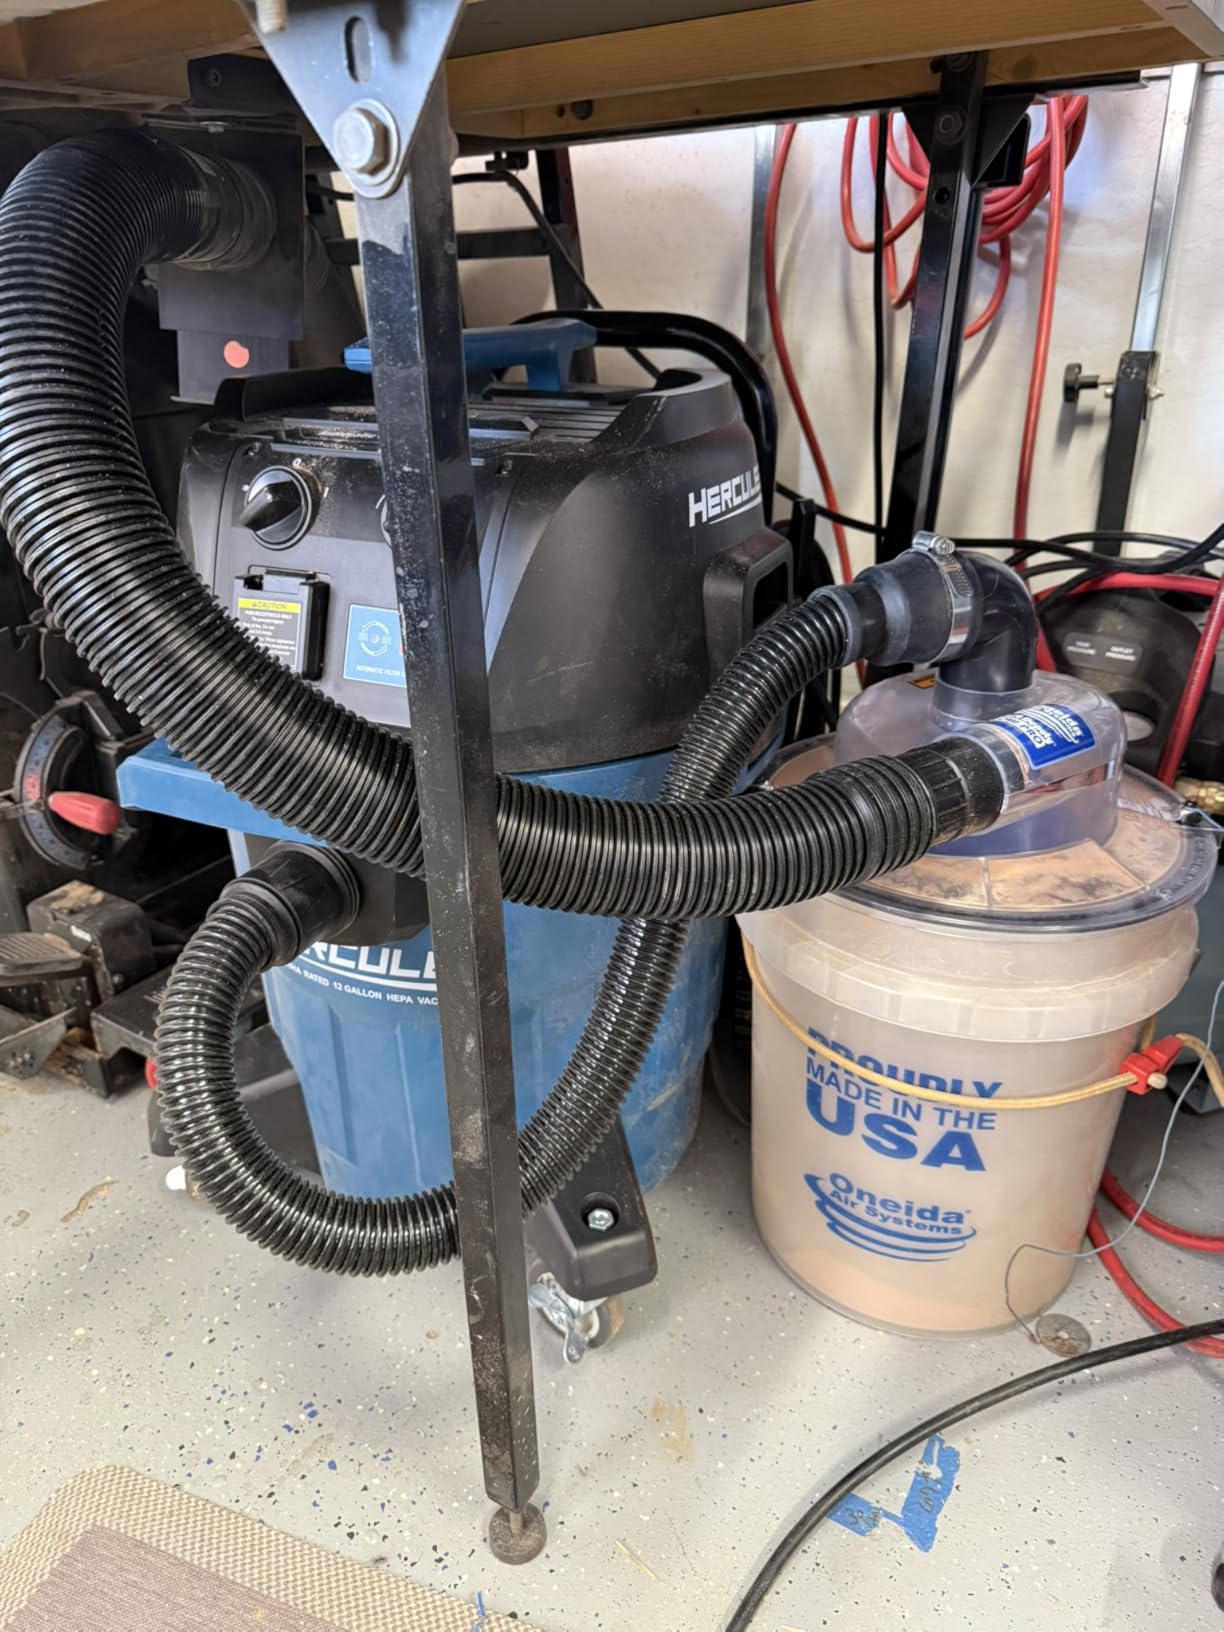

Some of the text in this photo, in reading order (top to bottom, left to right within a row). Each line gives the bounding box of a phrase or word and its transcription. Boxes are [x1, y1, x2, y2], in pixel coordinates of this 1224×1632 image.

[257, 600, 287, 610] CAUTION
[303, 969, 329, 986] RATED
[333, 981, 343, 992] 12
[344, 984, 382, 1001] GALLON
[386, 993, 413, 1005] HEPA
[807, 1056, 997, 1130] MADE IN THE
[806, 1077, 987, 1172] USA
[830, 1172, 965, 1225] Oneida
[830, 1189, 962, 1235] Air Systems
